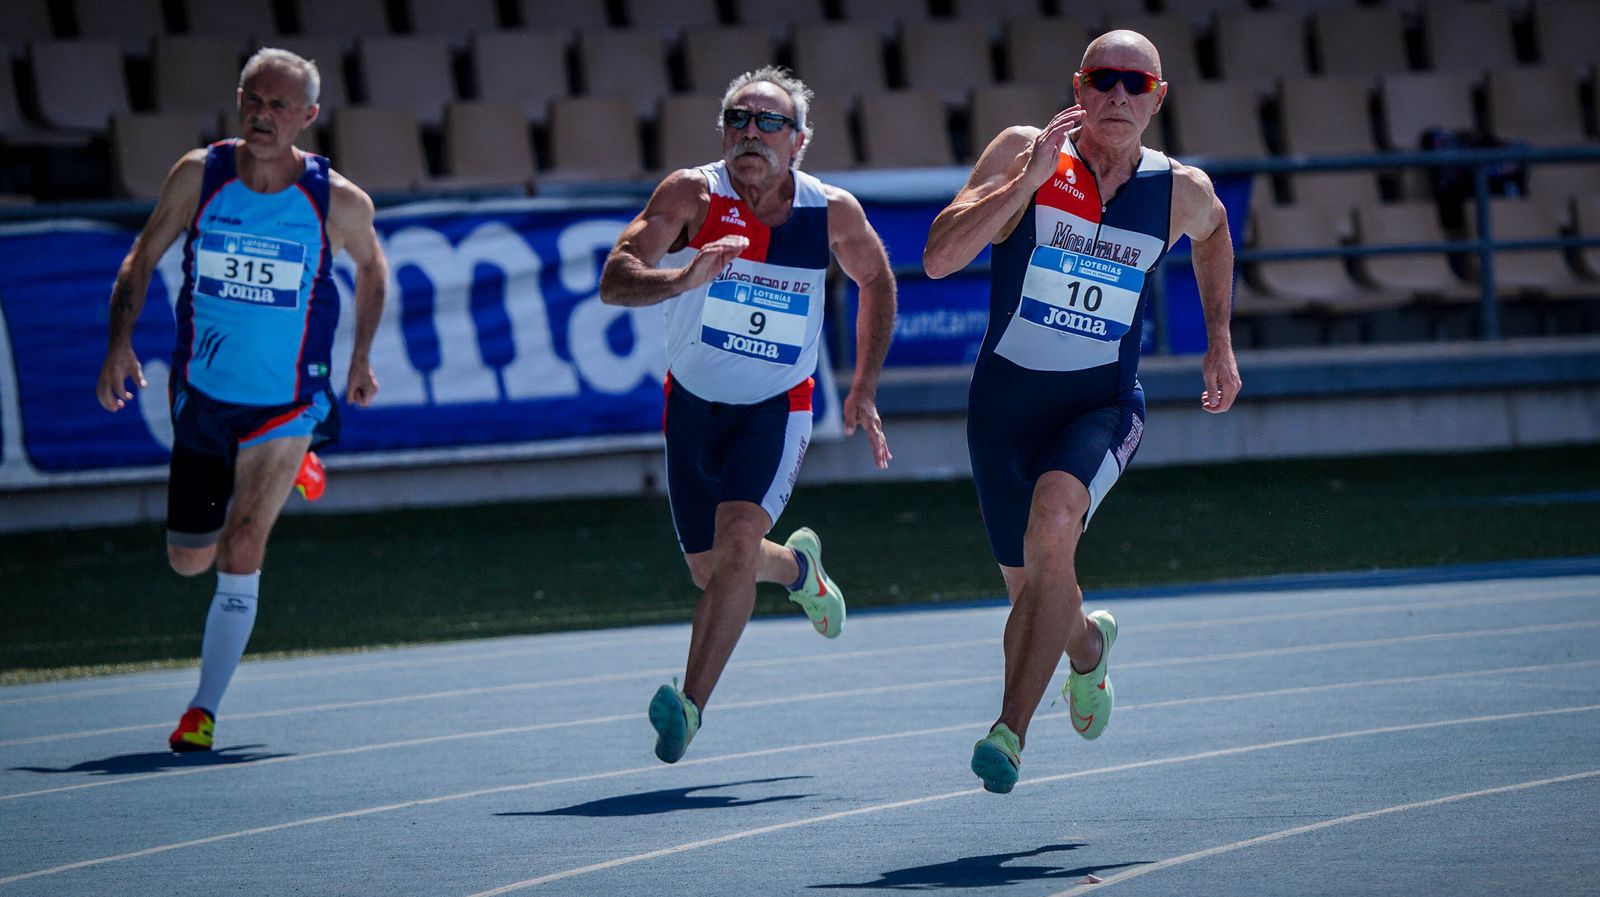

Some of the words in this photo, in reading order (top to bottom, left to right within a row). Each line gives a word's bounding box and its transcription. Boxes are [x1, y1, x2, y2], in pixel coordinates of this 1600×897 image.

[1053, 178, 1085, 201] VIATOR
[721, 215, 747, 228] VIATOR
[224, 257, 275, 285] 315
[1080, 259, 1122, 276] LOTERÍAS
[753, 289, 792, 304] LOTERÍAS
[1067, 281, 1103, 312] 10
[748, 311, 767, 335] 9
